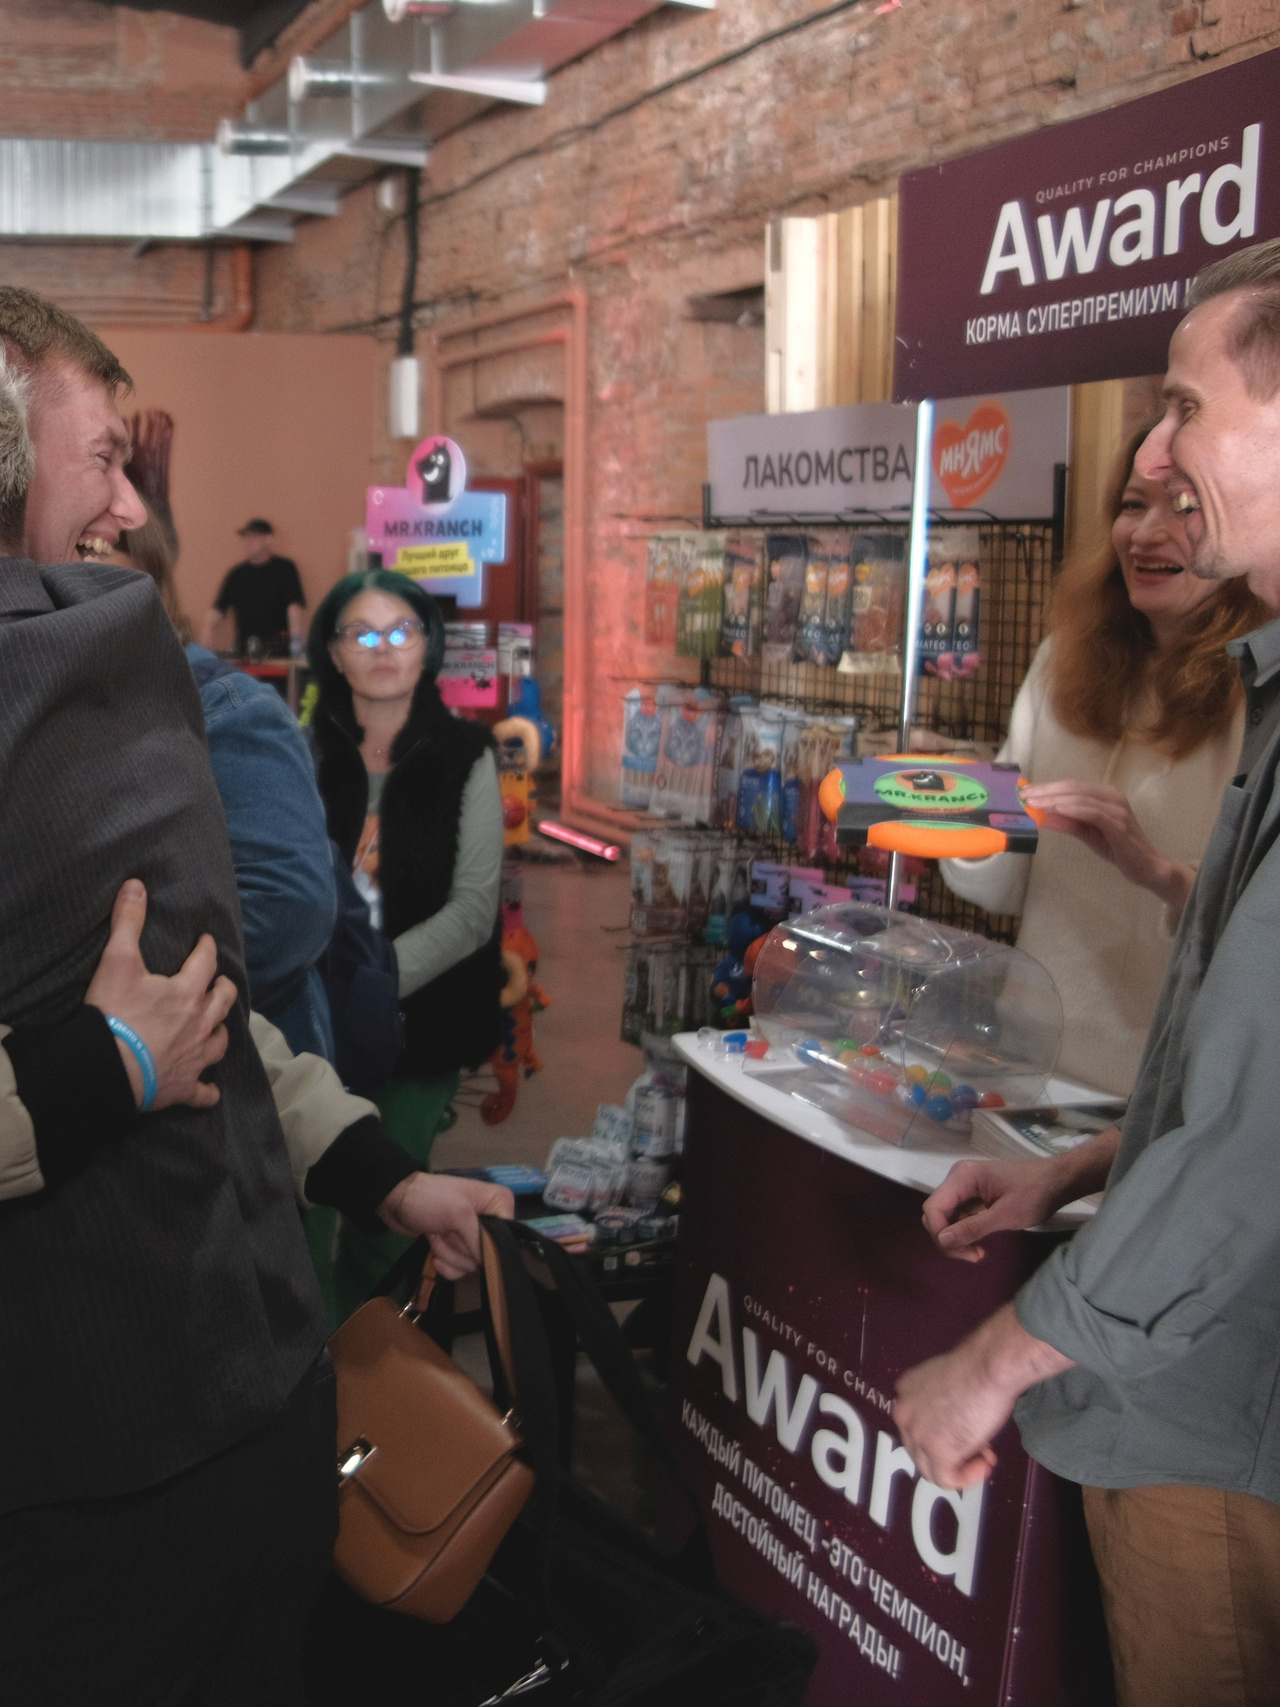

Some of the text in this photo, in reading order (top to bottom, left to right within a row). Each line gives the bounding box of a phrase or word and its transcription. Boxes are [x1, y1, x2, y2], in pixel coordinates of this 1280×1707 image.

[979, 122, 1262, 296] Award
[1035, 135, 1231, 204] QUALITY FOR CHAMPIONS
[965, 312, 1023, 346] КОРМА
[1025, 281, 1179, 335] СУПЕРПРЕМИУМ
[741, 442, 913, 489] ЛАКОМСТВА
[383, 518, 484, 538] MR.KRANCH
[743, 1294, 803, 1348] QUALITY
[806, 1341, 839, 1375] FOR
[686, 1272, 987, 1598] Award
[681, 1398, 741, 1477] КАЖДЫЙ
[741, 1457, 818, 1554] ПИТОМЕЦ
[867, 1570, 971, 1687] ЧЕМПИОН,
[711, 1483, 902, 1680] ДОСТОЙНЫЙ НАГРАДЫ!
